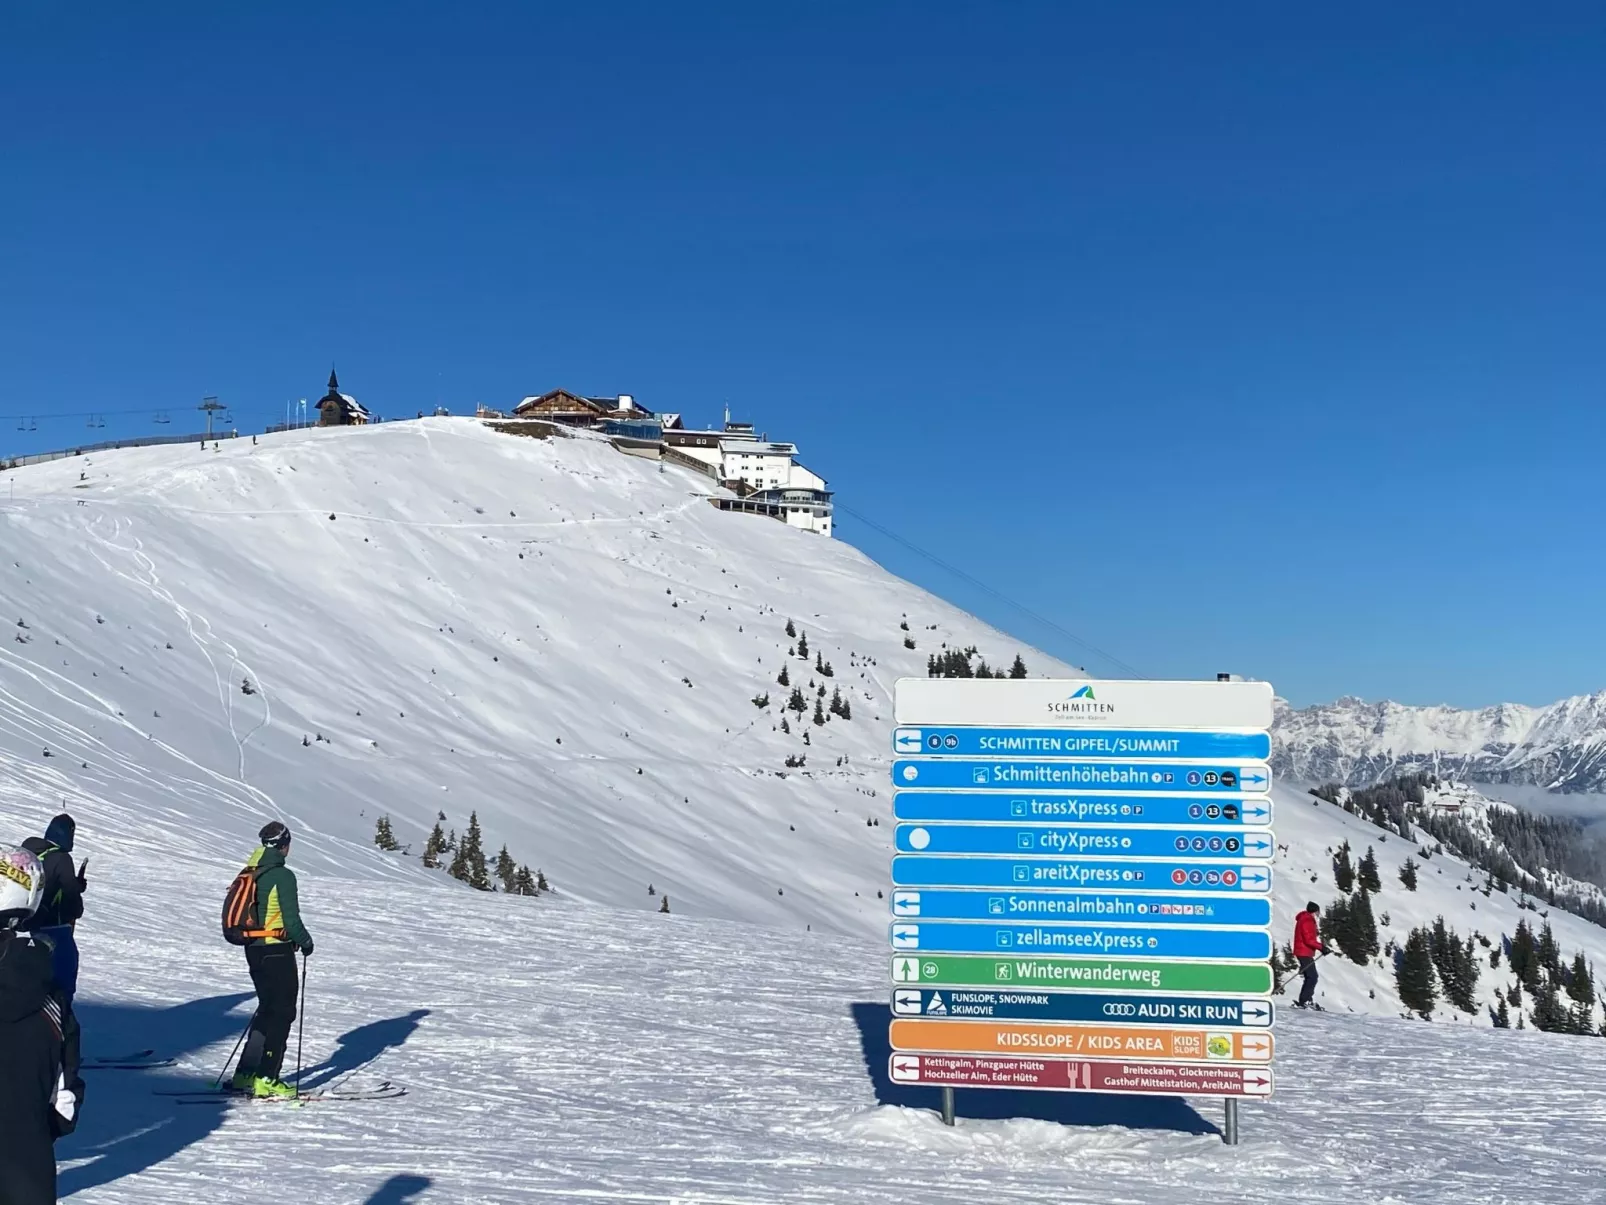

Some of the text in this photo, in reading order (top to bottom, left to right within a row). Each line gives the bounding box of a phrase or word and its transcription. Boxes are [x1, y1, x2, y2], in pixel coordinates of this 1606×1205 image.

[1047, 702, 1115, 713] SCHMITTEN
[945, 738, 956, 746] 9b
[979, 737, 1180, 753] SCHMITTEN GIPFEL/SUMMIT
[994, 766, 1148, 783] Schmittenhöhebahn
[1206, 774, 1216, 783] 13
[1031, 800, 1116, 819] trassXpress
[1208, 807, 1218, 815] 13
[1040, 831, 1118, 851] cityXpress
[1033, 864, 1119, 884] areitXpress
[1208, 873, 1217, 881] 3a
[1009, 896, 1134, 914] Sonnenalmbahn
[1017, 929, 1143, 950] zellamseeXpress
[926, 966, 935, 974] 28
[1016, 963, 1161, 986] Winterwanderweg
[952, 993, 1049, 1004] FUNSLOPE, SNOWPARK
[952, 1005, 993, 1015] SKIMOVIE
[1138, 1004, 1238, 1019] AUDI SKI RUN
[997, 1033, 1072, 1047] KIDSSLOPE
[1088, 1036, 1121, 1049] KIDS
[1125, 1037, 1164, 1050] AREA
[1174, 1036, 1199, 1046] KIDS
[1174, 1046, 1200, 1054] SLOPE
[924, 1058, 1044, 1071] Kettingalm, Pinzgauer Hütte
[924, 1070, 969, 1081] Hochzeller
[992, 1072, 1011, 1082] Eder
[1013, 1073, 1038, 1082] Hütte
[1124, 1066, 1241, 1079] Breiteckalm, Glocknerhaus,
[1104, 1077, 1241, 1090] Gasthof Mittelstation, AreitAlm
